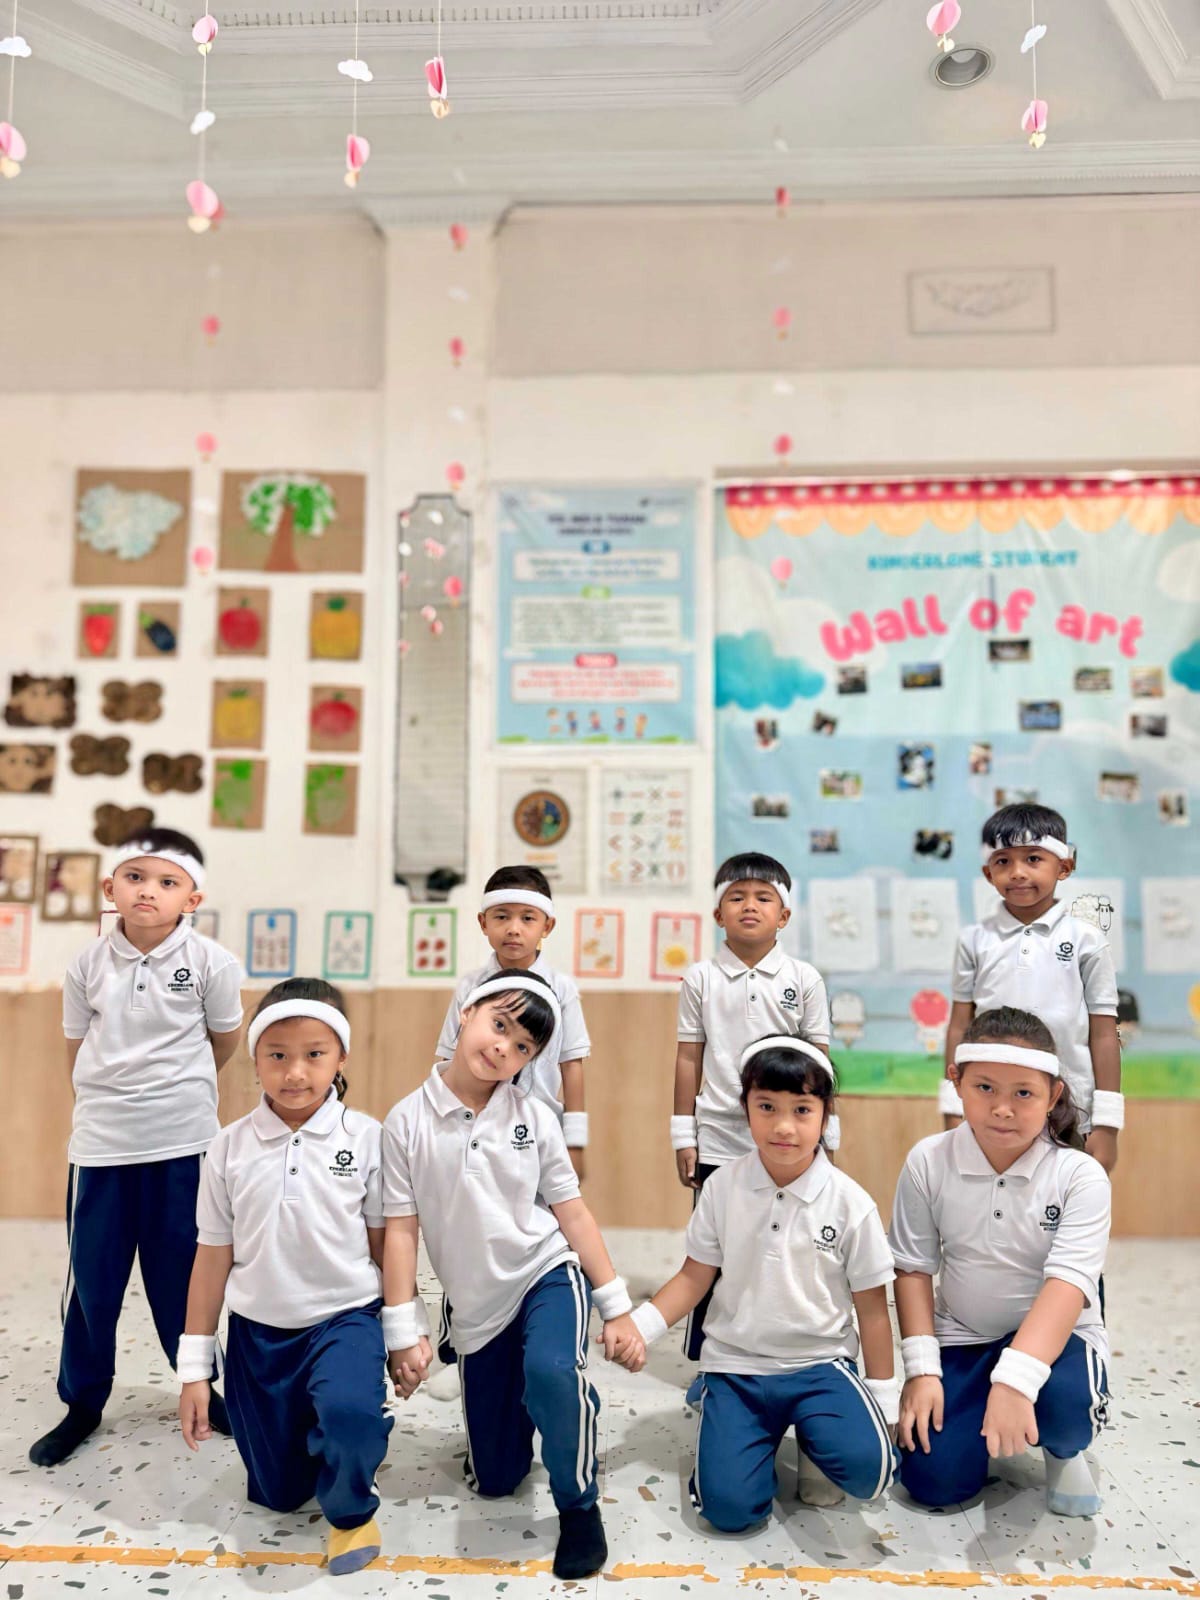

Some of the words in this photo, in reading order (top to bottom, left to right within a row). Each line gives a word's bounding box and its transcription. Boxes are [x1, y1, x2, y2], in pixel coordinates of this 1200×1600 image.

[990, 550, 1079, 568] STUDENT
[969, 588, 1036, 634] of
[1055, 604, 1145, 659] art
